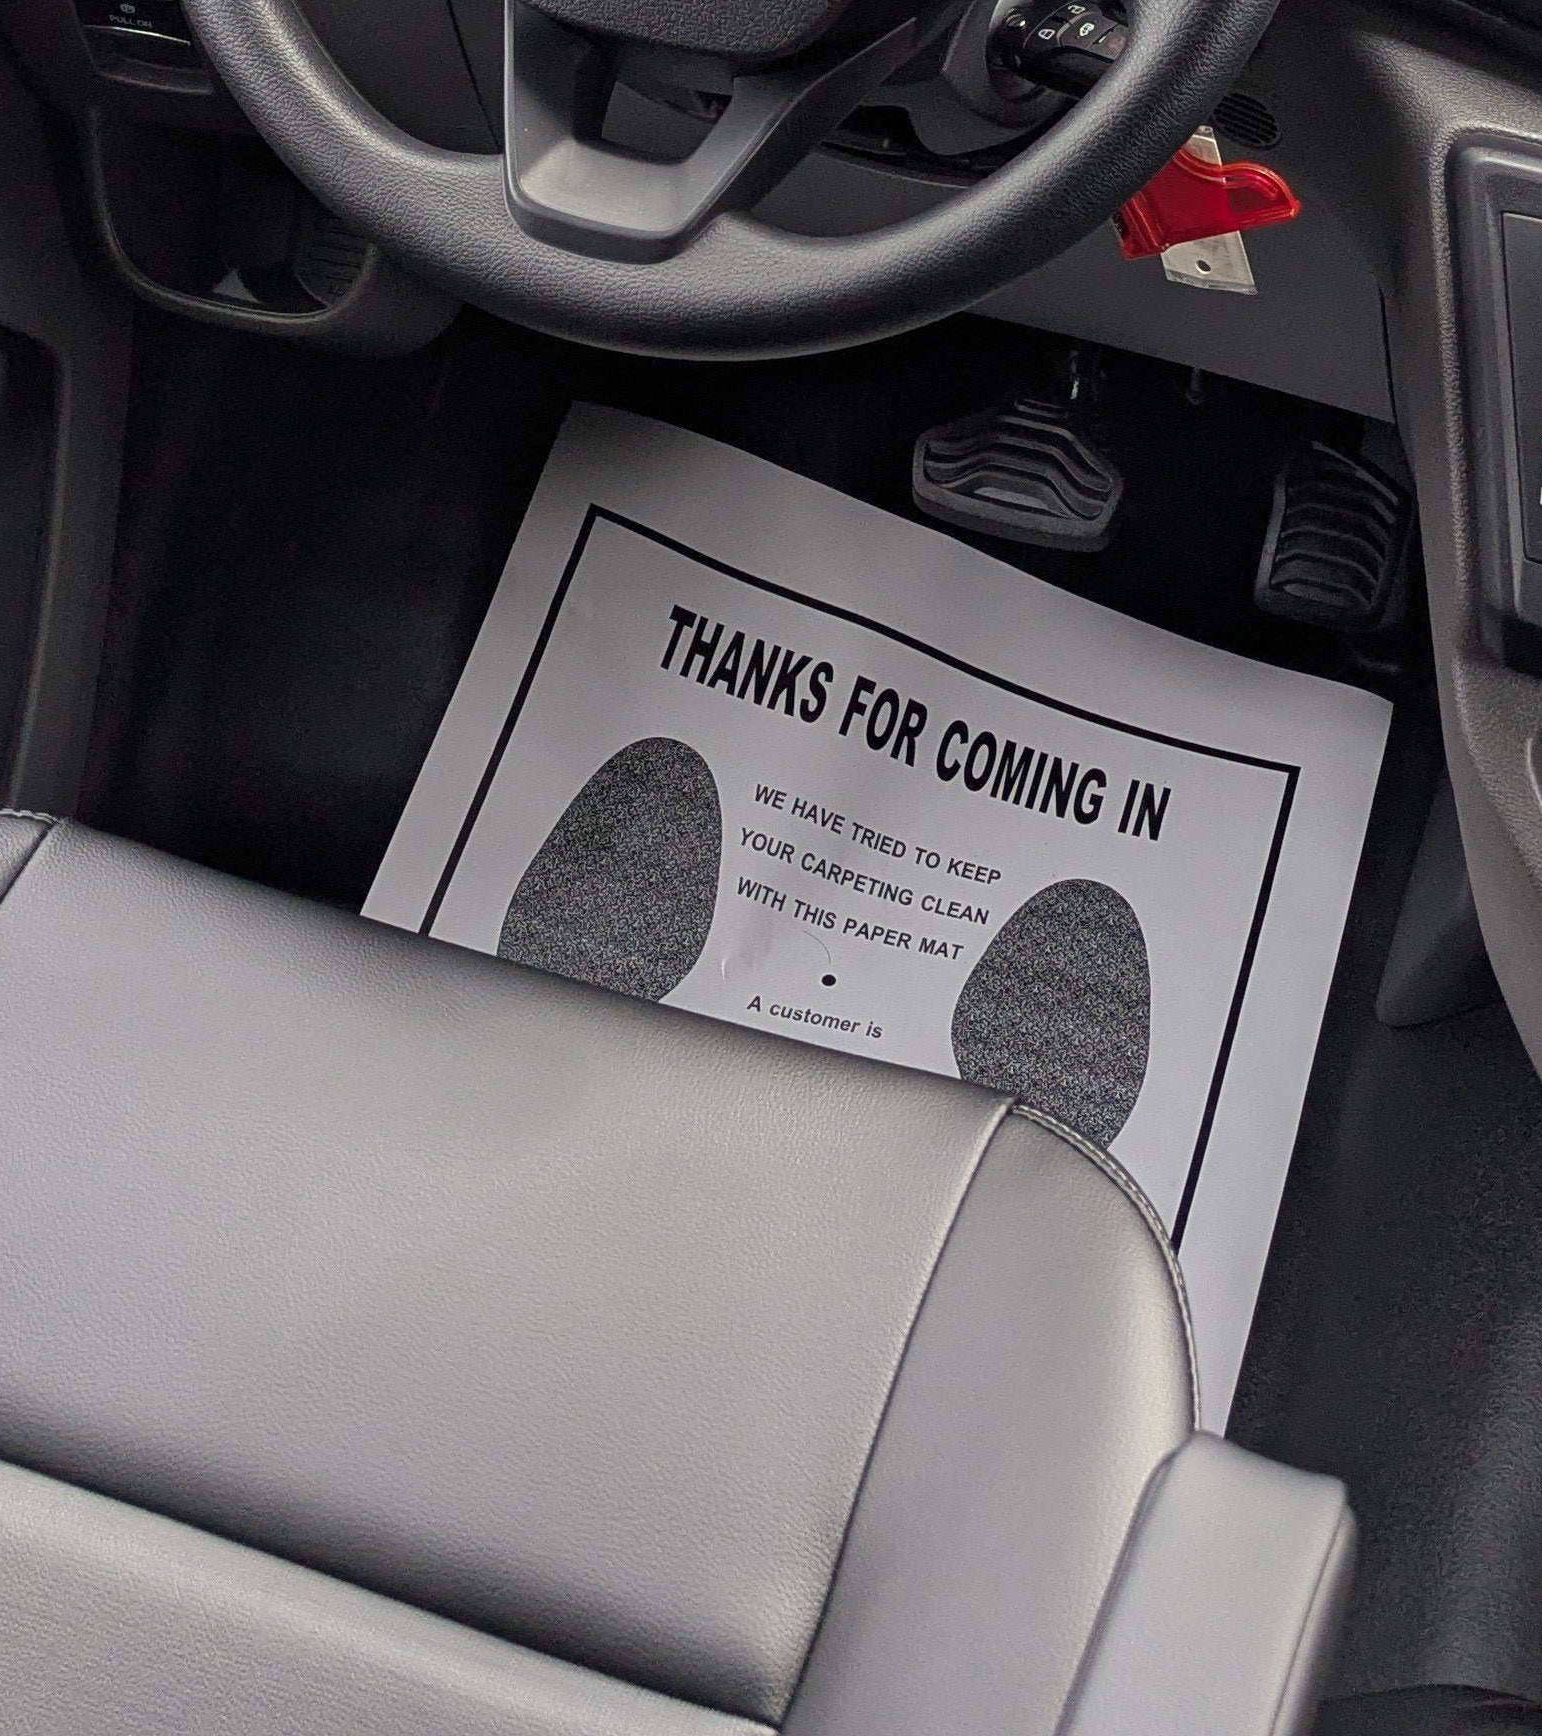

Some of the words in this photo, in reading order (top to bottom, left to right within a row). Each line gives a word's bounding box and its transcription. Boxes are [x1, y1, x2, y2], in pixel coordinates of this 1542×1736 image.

[659, 605, 831, 723] THANKS
[839, 676, 926, 766] FOR
[936, 720, 1105, 826] COMING
[1120, 777, 1172, 842] IN
[738, 828, 796, 865] YOUR
[799, 851, 915, 908] CARPETING
[919, 887, 991, 927] CLEAN
[753, 784, 786, 811] WE
[790, 796, 844, 833] HAVE
[850, 822, 909, 859] TRIED
[912, 845, 943, 869] TO
[947, 854, 1004, 886] KEEP
[737, 876, 788, 913] WITH
[791, 898, 839, 931] THIS
[842, 914, 912, 949] PAPER
[918, 933, 967, 961] MAT
[746, 996, 762, 1013] A
[767, 1001, 860, 1034] customer
[865, 1022, 883, 1038] is
